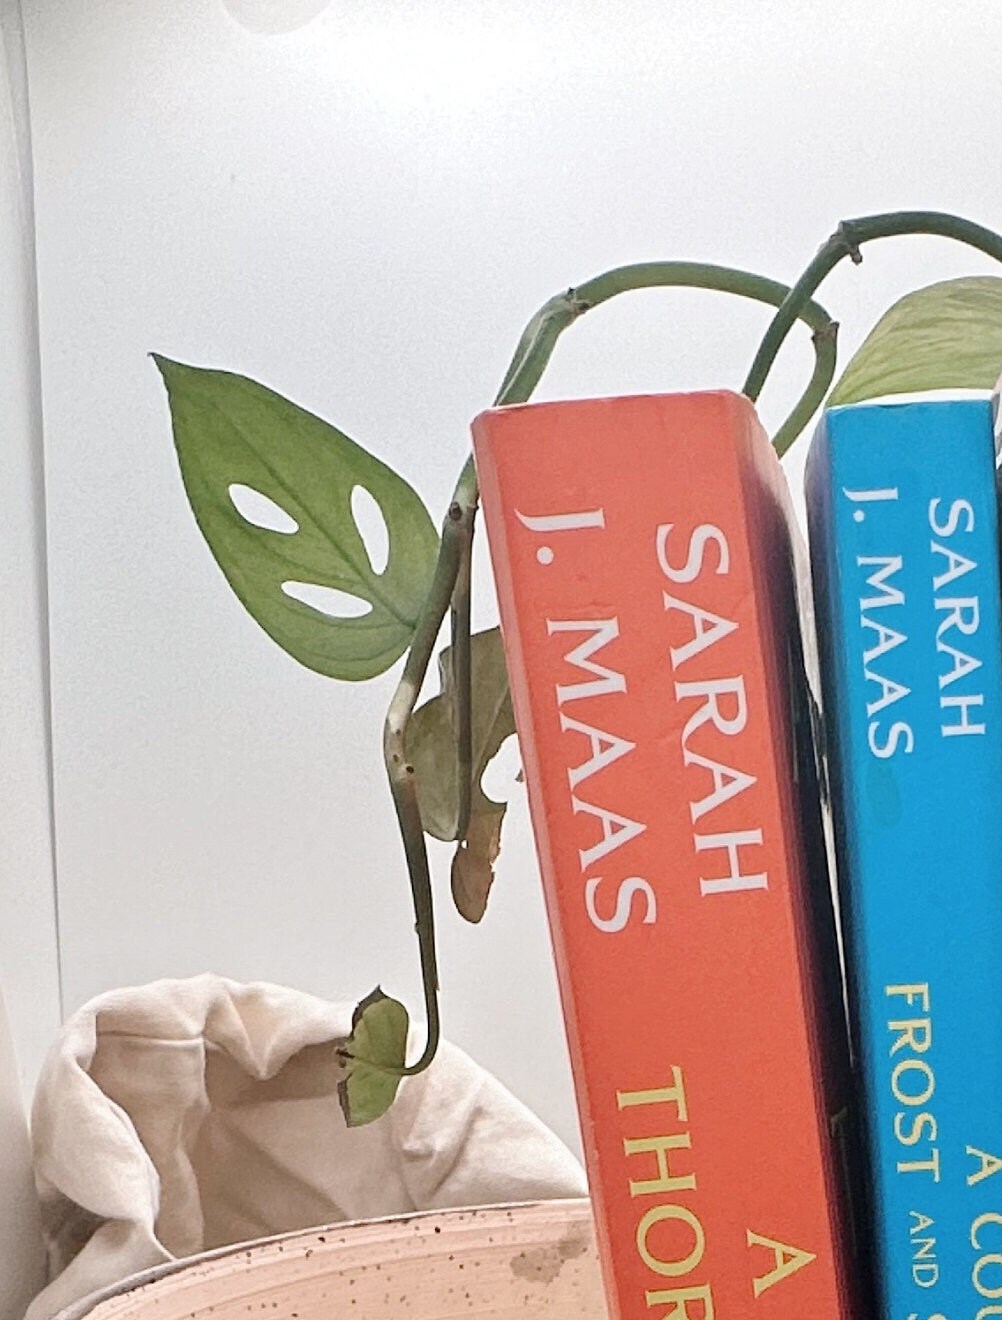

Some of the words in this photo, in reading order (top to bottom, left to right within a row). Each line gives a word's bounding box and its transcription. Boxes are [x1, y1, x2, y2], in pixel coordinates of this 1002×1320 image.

[514, 507, 605, 566] J.
[842, 487, 899, 523] J.
[655, 522, 769, 897] SARAH
[857, 555, 914, 759] MAAS
[928, 498, 986, 738] SARAH
[546, 617, 657, 933] MAAS
[884, 981, 941, 1183] FROST
[746, 1229, 817, 1299] A
[908, 1210, 940, 1288] AND
